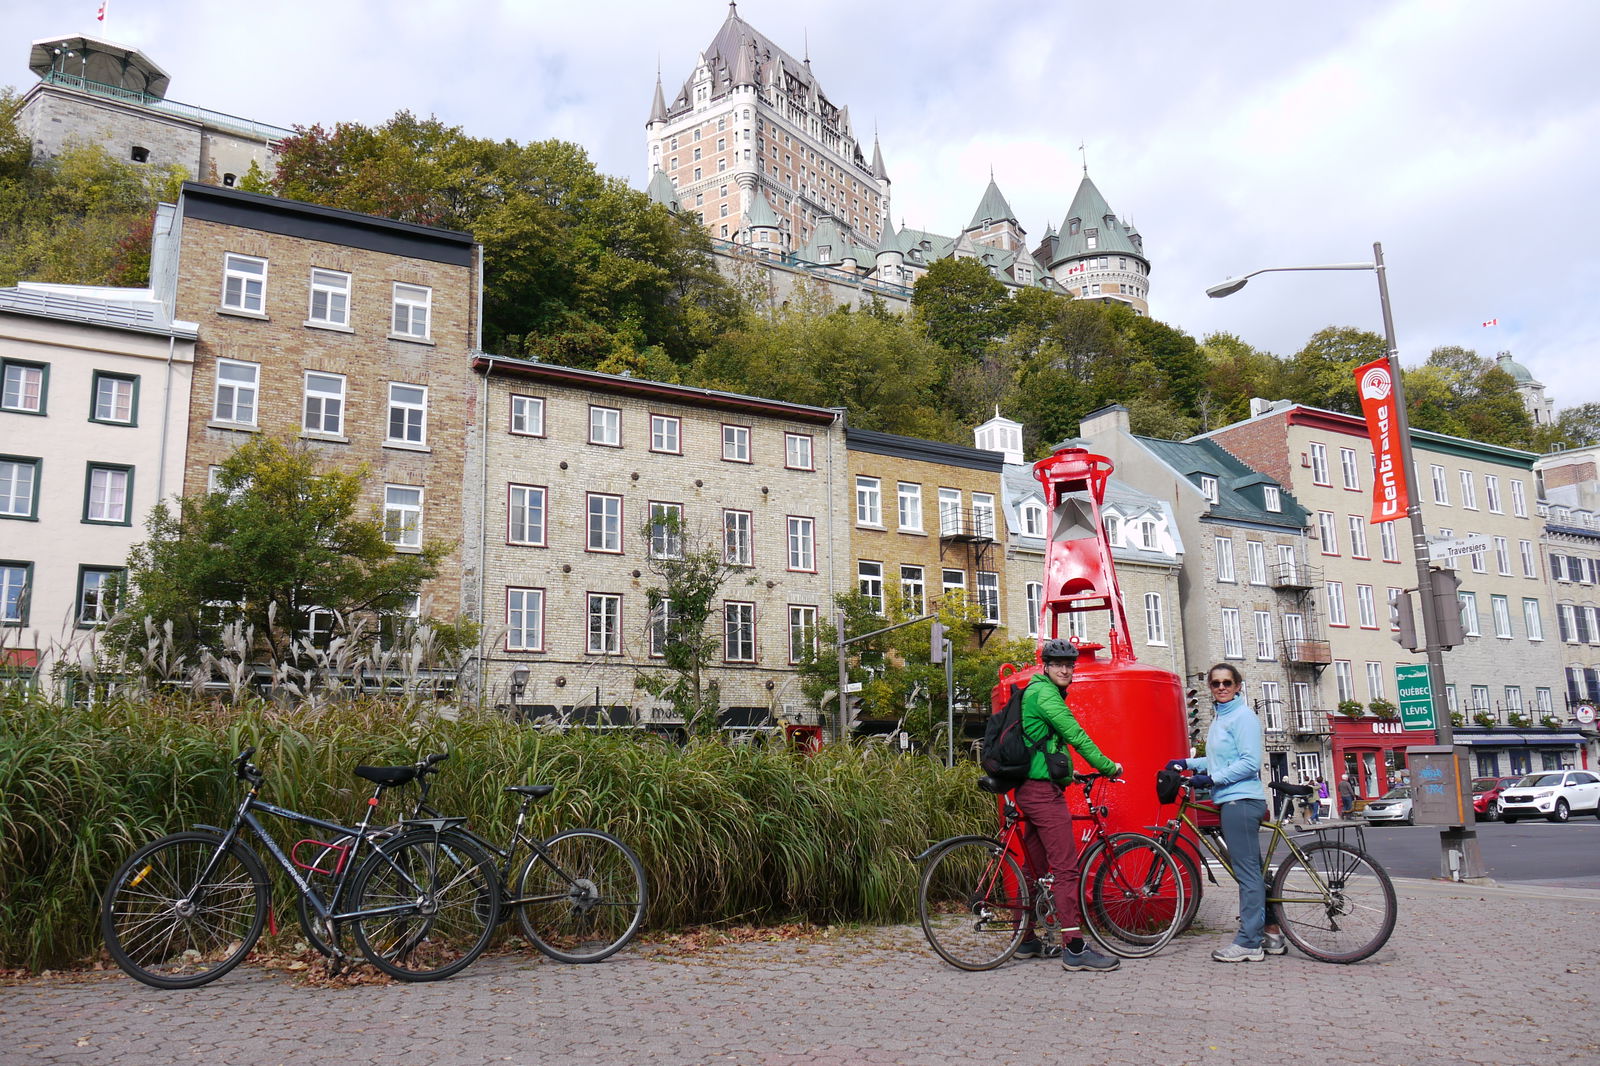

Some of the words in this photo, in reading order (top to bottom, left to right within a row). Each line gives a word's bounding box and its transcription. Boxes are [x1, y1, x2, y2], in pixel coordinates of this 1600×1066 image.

[1448, 543, 1487, 556] Traversiers
[1399, 686, 1429, 697] QUÉBEC
[1405, 705, 1428, 715] LÉVIS
